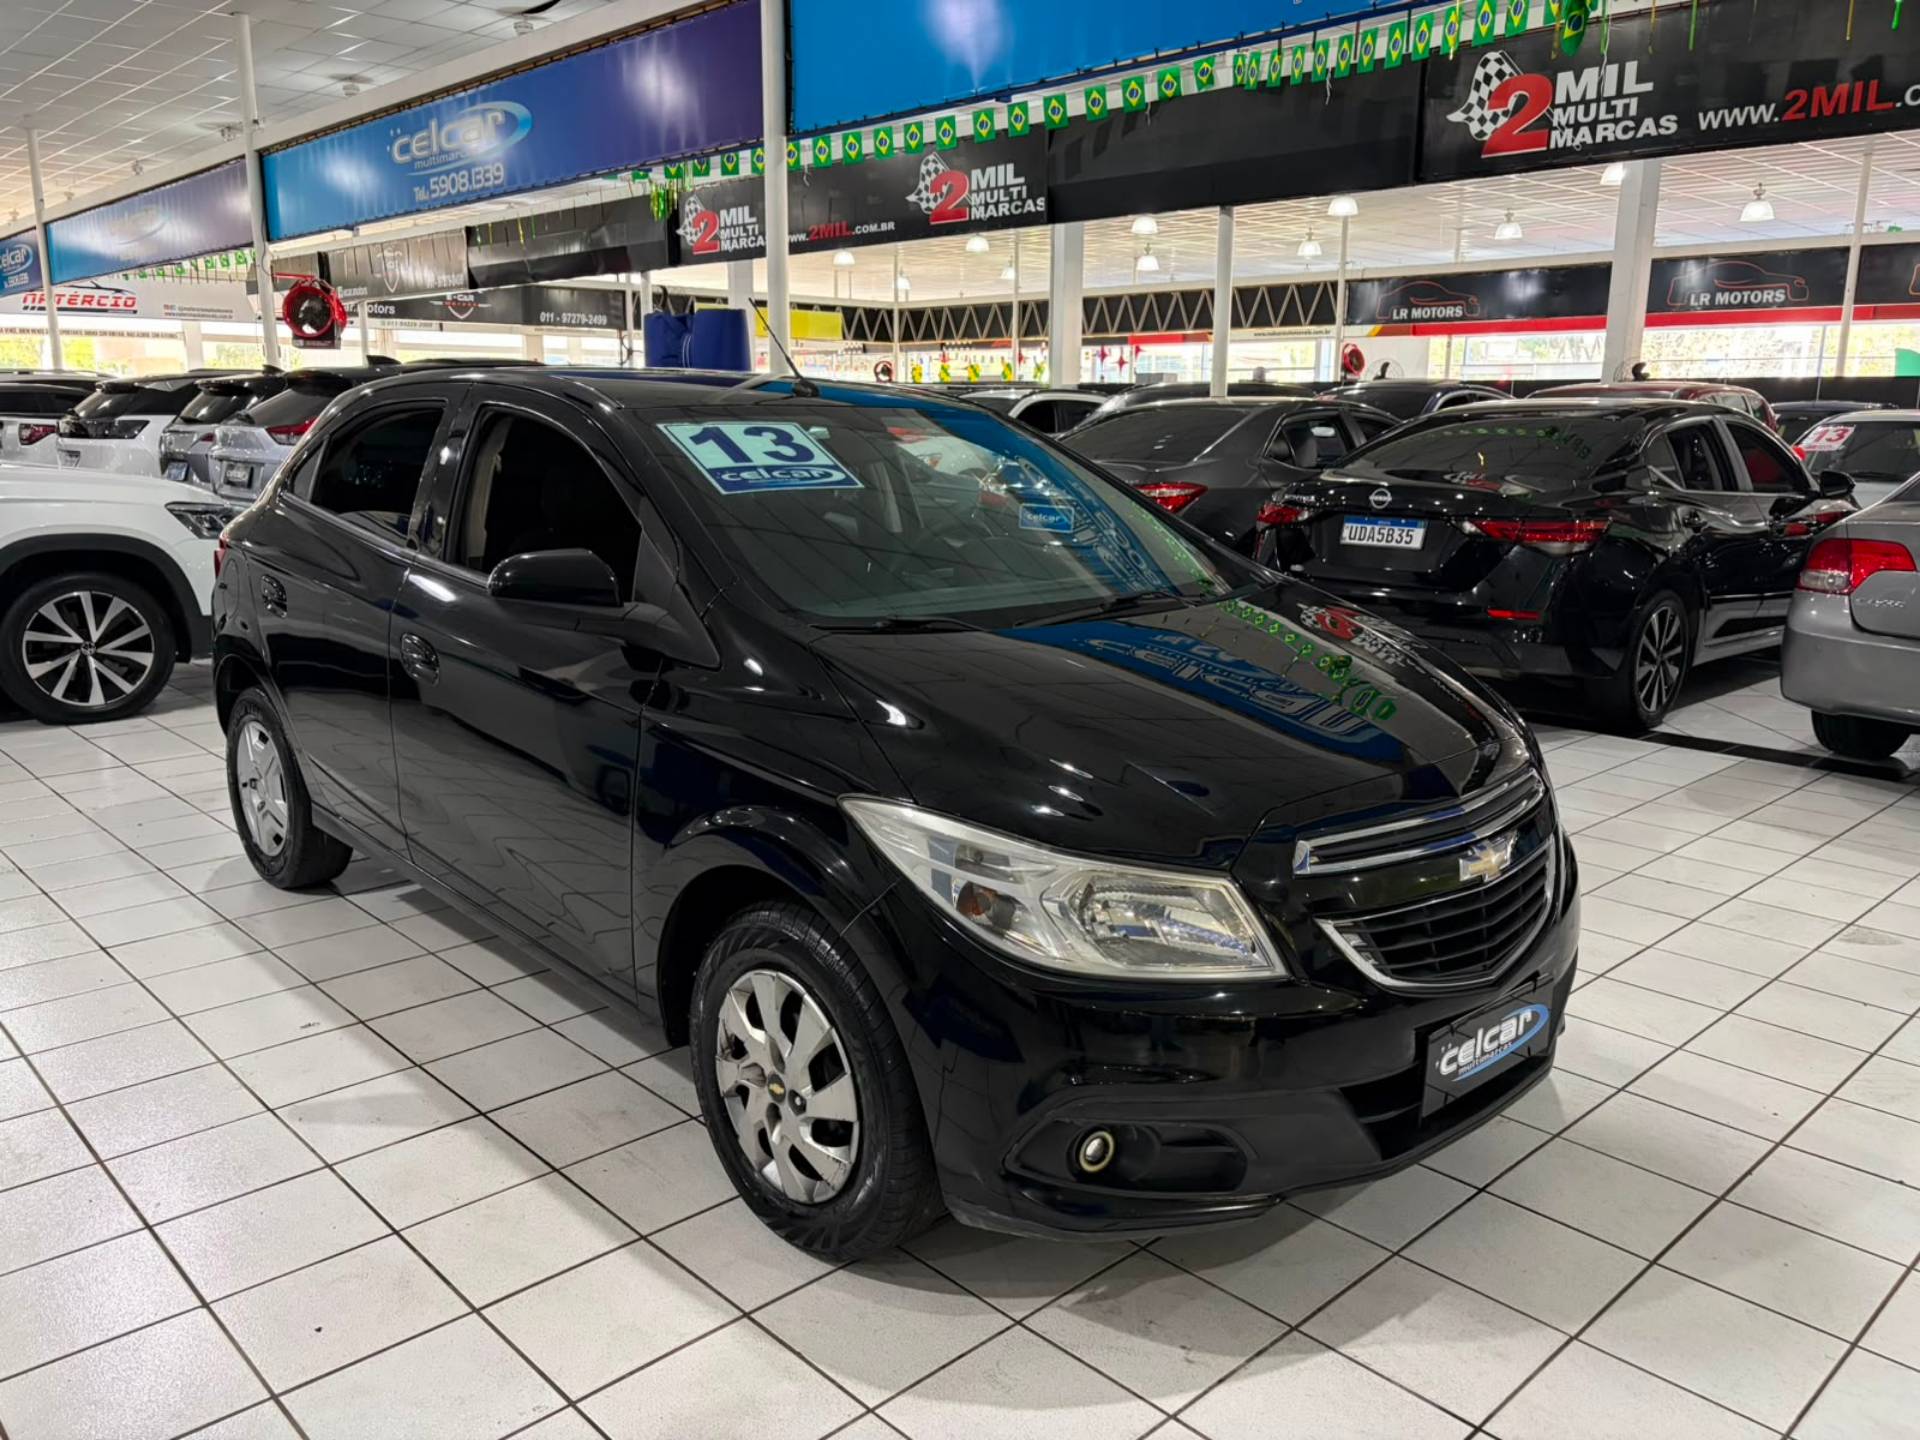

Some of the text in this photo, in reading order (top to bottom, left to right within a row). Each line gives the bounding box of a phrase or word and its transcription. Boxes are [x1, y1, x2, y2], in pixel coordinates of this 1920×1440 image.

[1481, 60, 1654, 158] 2 MIL
[1552, 97, 1638, 127] MULTI
[392, 110, 505, 164] celcar
[1550, 114, 1678, 150] MARCAS
[430, 162, 504, 198] 5908.1339
[929, 163, 1025, 225] 2 MIL
[971, 185, 1028, 207] MULTI
[971, 197, 1046, 221] MARCAS
[692, 206, 757, 255] 2 MIL
[720, 225, 760, 241] MULTI
[720, 235, 767, 251] MARCA
[0, 247, 27, 269] elcar
[1690, 289, 1786, 306] LR MOTORS
[540, 311, 555, 323] 011
[1392, 306, 1463, 320] LR MOTORS
[690, 426, 815, 464] 13
[1812, 428, 1851, 443] 13
[721, 467, 826, 482] celcar
[1348, 525, 1415, 545] UDA5B35
[1439, 1008, 1533, 1076] celcar
